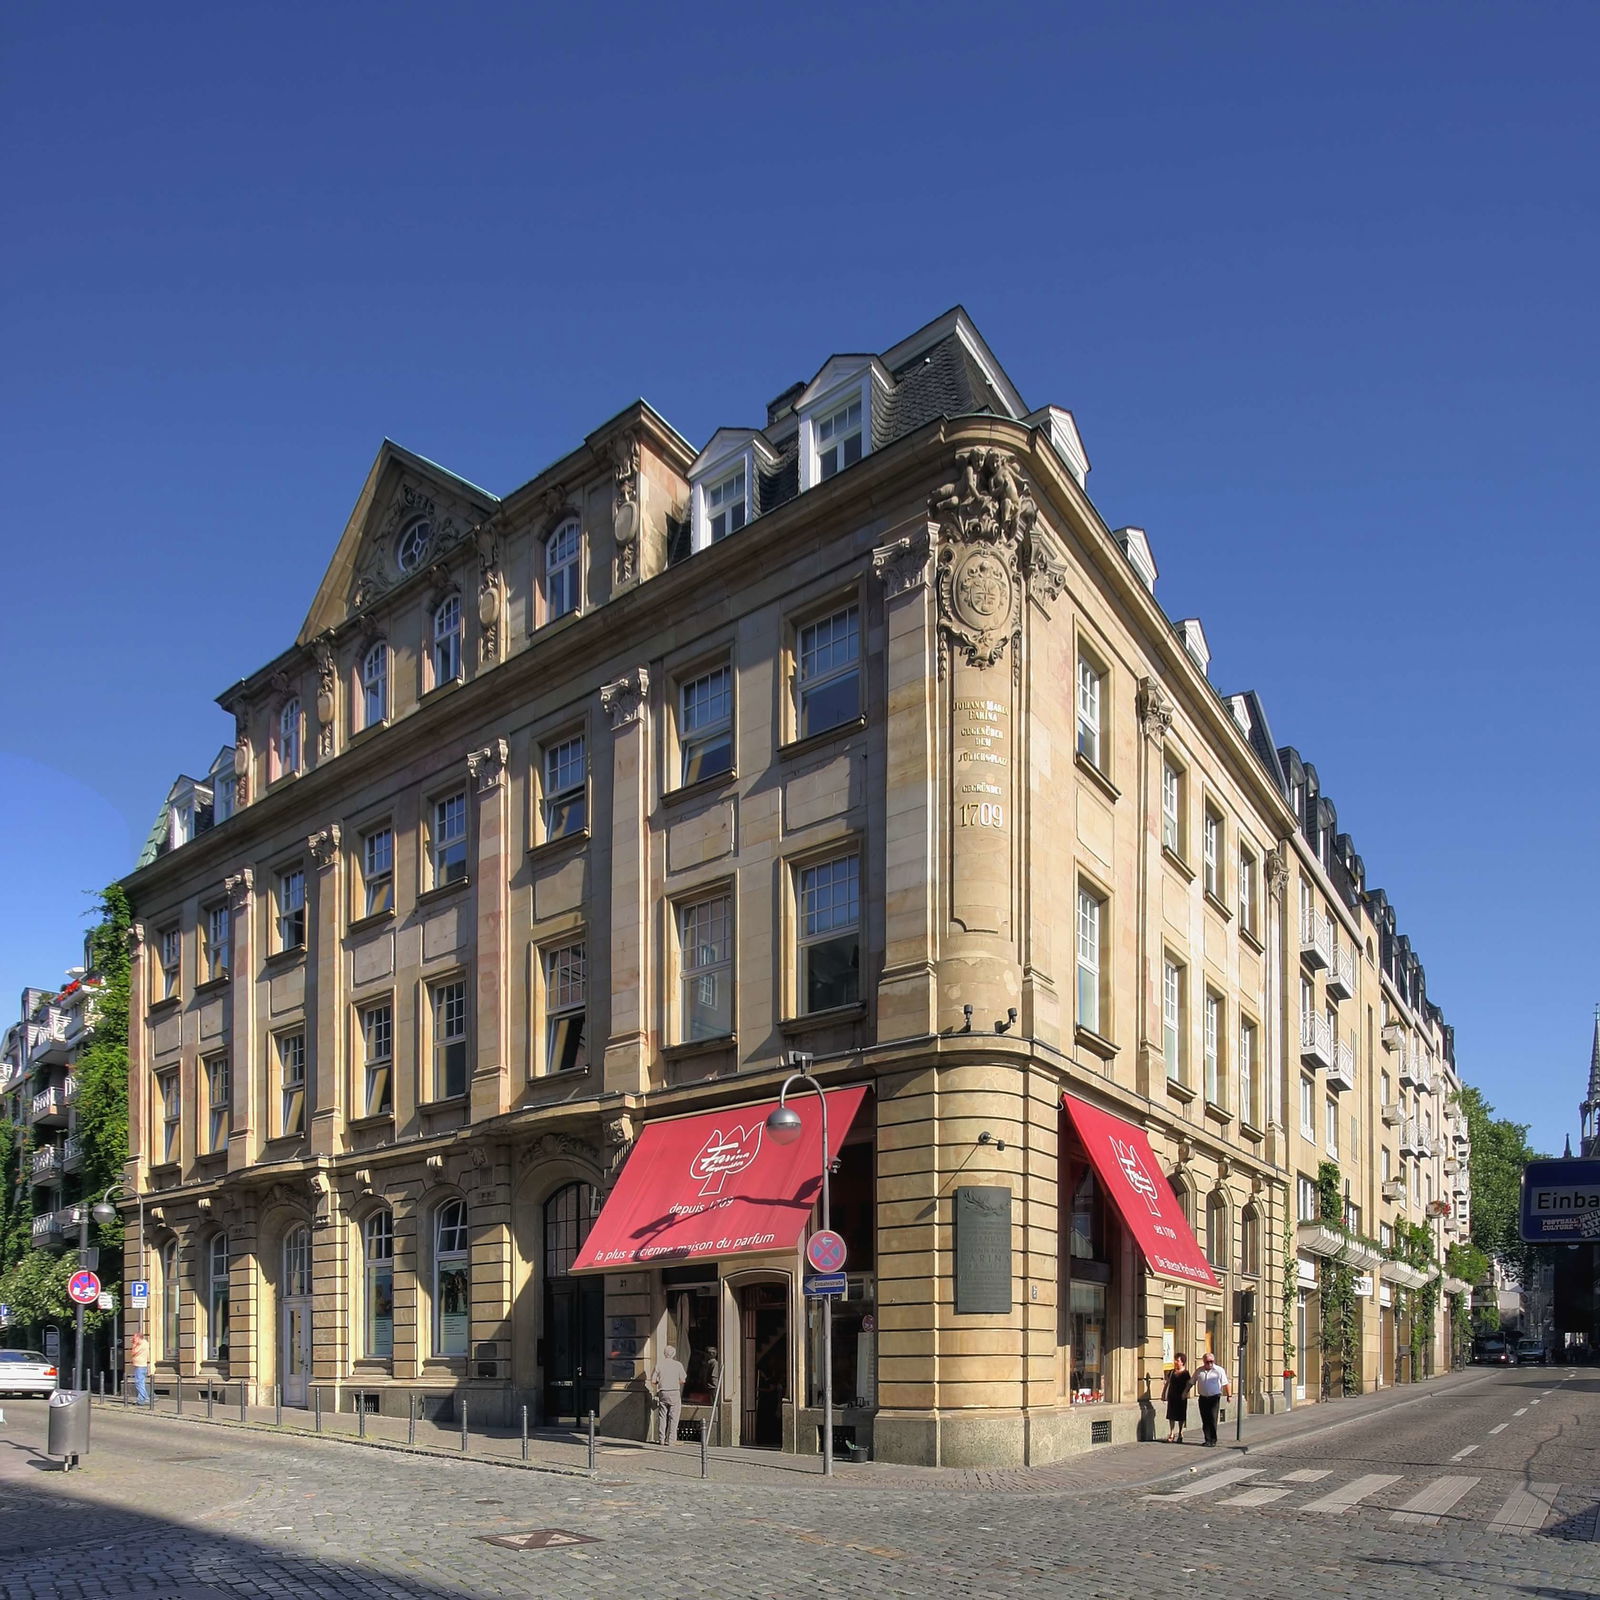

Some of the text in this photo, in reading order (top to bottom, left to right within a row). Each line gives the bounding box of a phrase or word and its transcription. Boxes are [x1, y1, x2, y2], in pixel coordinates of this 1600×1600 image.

[969, 710, 998, 722] FARINA
[975, 737, 992, 747] DEM
[960, 803, 1003, 829] 1709
[700, 1142, 750, 1170] Farina
[669, 1202, 705, 1216] depuis
[595, 1232, 775, 1262] la plus ancienne maison du parfum
[135, 1284, 145, 1296] P
